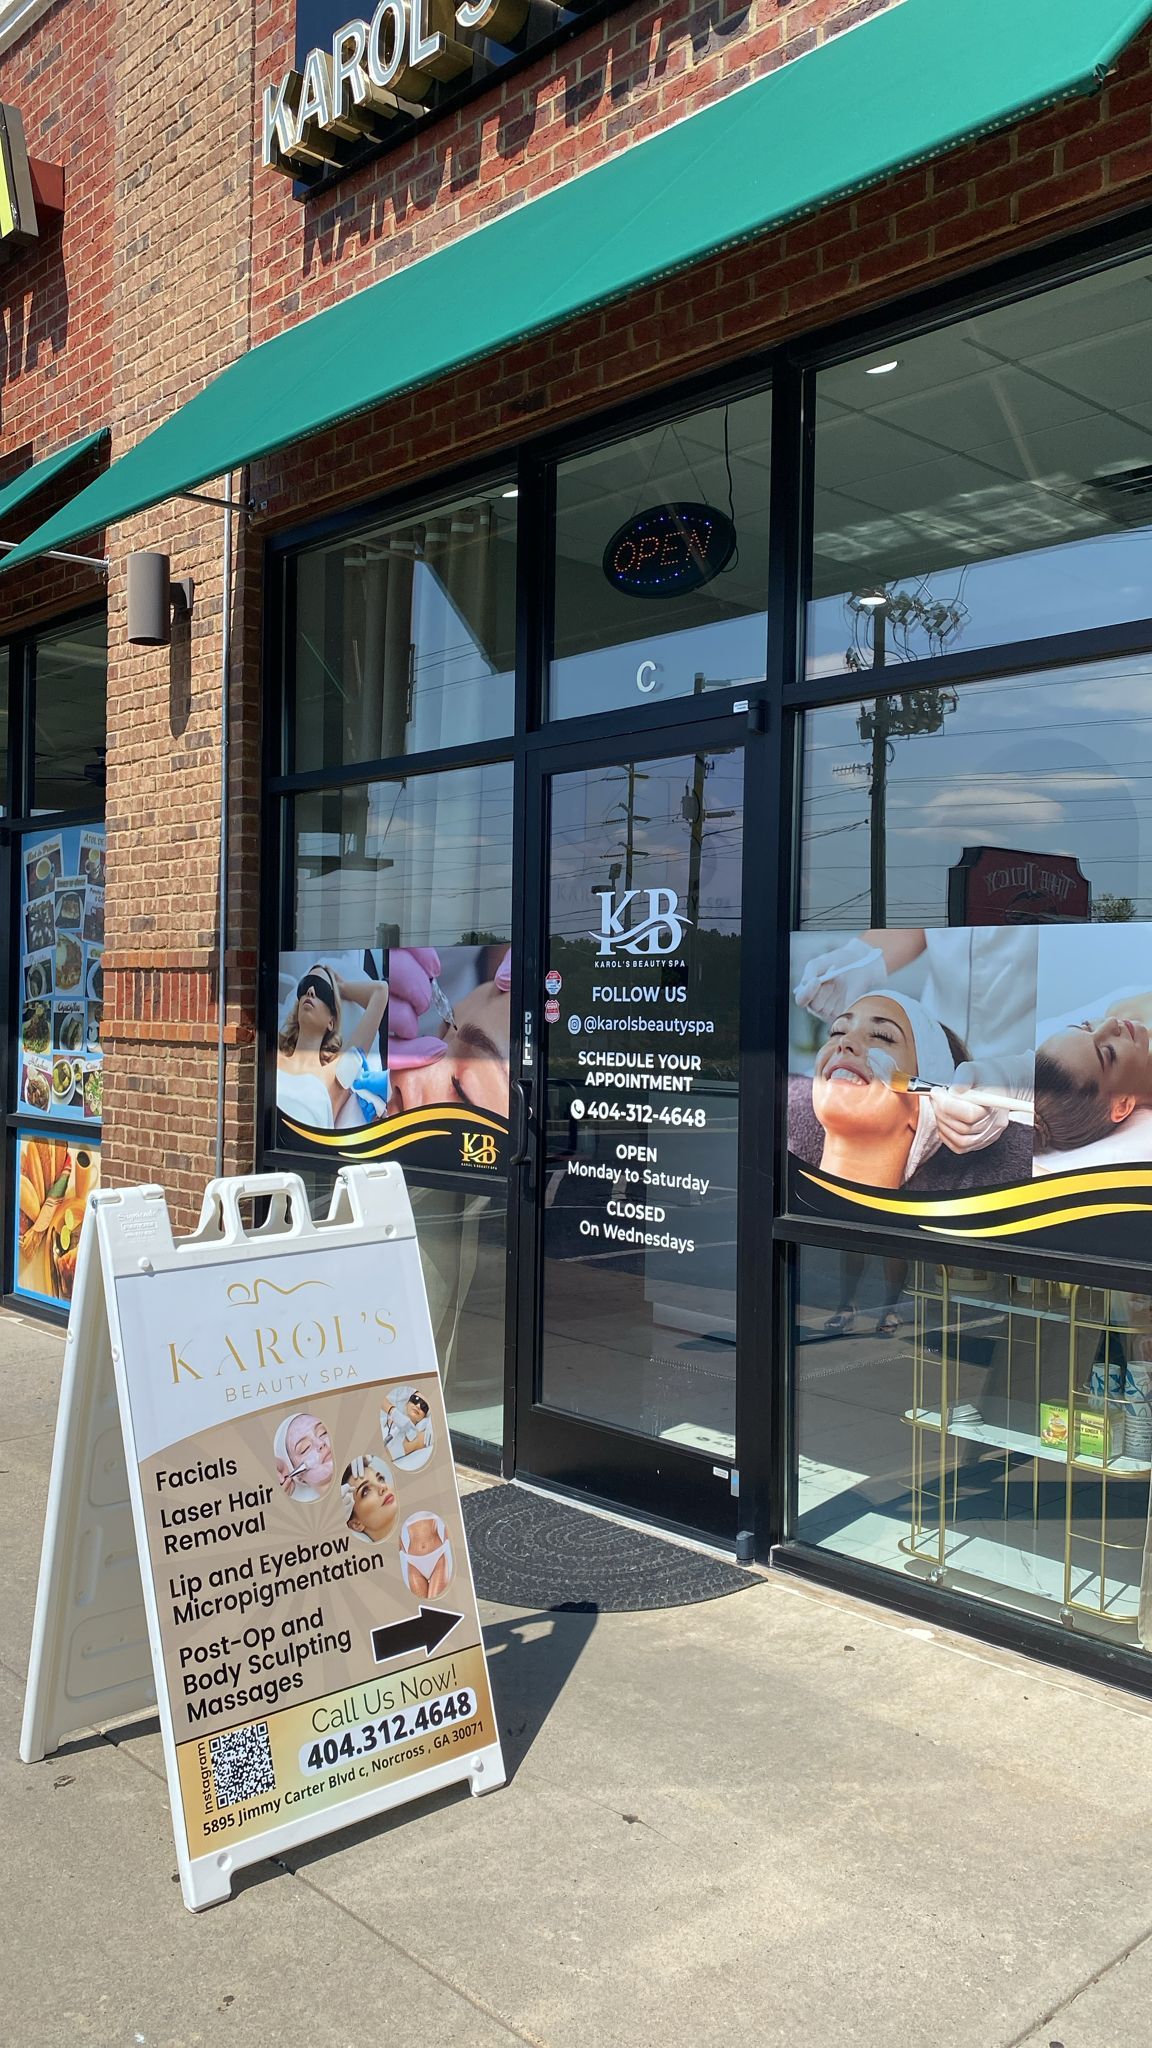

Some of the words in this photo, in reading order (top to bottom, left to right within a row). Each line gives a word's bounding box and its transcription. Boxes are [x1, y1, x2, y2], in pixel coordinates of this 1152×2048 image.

[262, 0, 498, 168] KAROL
[614, 525, 713, 572] OPEN
[636, 660, 657, 692] C
[588, 888, 694, 956] KB
[632, 960, 666, 968] BEAUTY
[668, 960, 686, 968] SPA
[592, 986, 660, 1002] FOLLOW
[664, 986, 688, 1003] US
[524, 1011, 532, 1060] PULL
[584, 1015, 715, 1036] @karolsbeautyspa
[578, 1051, 654, 1068] SCHEDULE
[658, 1054, 702, 1071] YOUR
[585, 1071, 694, 1092] APPOINTMENT
[587, 1101, 707, 1128] 404-312-4648
[459, 1132, 500, 1164] KB
[616, 1144, 658, 1162] OPEN
[567, 1160, 622, 1184] Monday
[625, 1168, 640, 1183] to
[642, 1169, 710, 1195] Saturday
[606, 1200, 666, 1223] CLOSED
[579, 1220, 600, 1237] On
[603, 1223, 695, 1254] Wednesdays
[168, 1307, 398, 1384] KAROL'S
[225, 1373, 309, 1403] BEAUTY
[320, 1364, 359, 1384] SPA
[156, 1457, 238, 1492] Facials
[160, 1499, 223, 1529] Laser
[228, 1484, 274, 1513] Hair
[164, 1512, 267, 1555] Removal
[169, 1574, 203, 1601] Lip
[208, 1558, 254, 1588] and
[259, 1536, 350, 1578] Eyebrow
[173, 1553, 385, 1626] Micropigmentation
[179, 1626, 276, 1668] Post-Op
[281, 1607, 324, 1638] and
[183, 1662, 242, 1695] Body
[248, 1629, 352, 1675] Sculpting
[186, 1672, 304, 1723] Massages
[311, 1697, 360, 1733] Call
[363, 1688, 395, 1715] Us
[400, 1663, 458, 1710] Now!
[307, 1691, 473, 1770] 404.312.4648
[197, 1741, 212, 1815] Instagram
[203, 1812, 236, 1837] 5895
[237, 1799, 281, 1828] Jimmy
[284, 1782, 326, 1806] Carter
[328, 1769, 356, 1789] Blvd
[358, 1767, 369, 1779] c,
[371, 1743, 425, 1774] Norcross
[433, 1734, 450, 1751] GA
[452, 1720, 485, 1744] 30071
